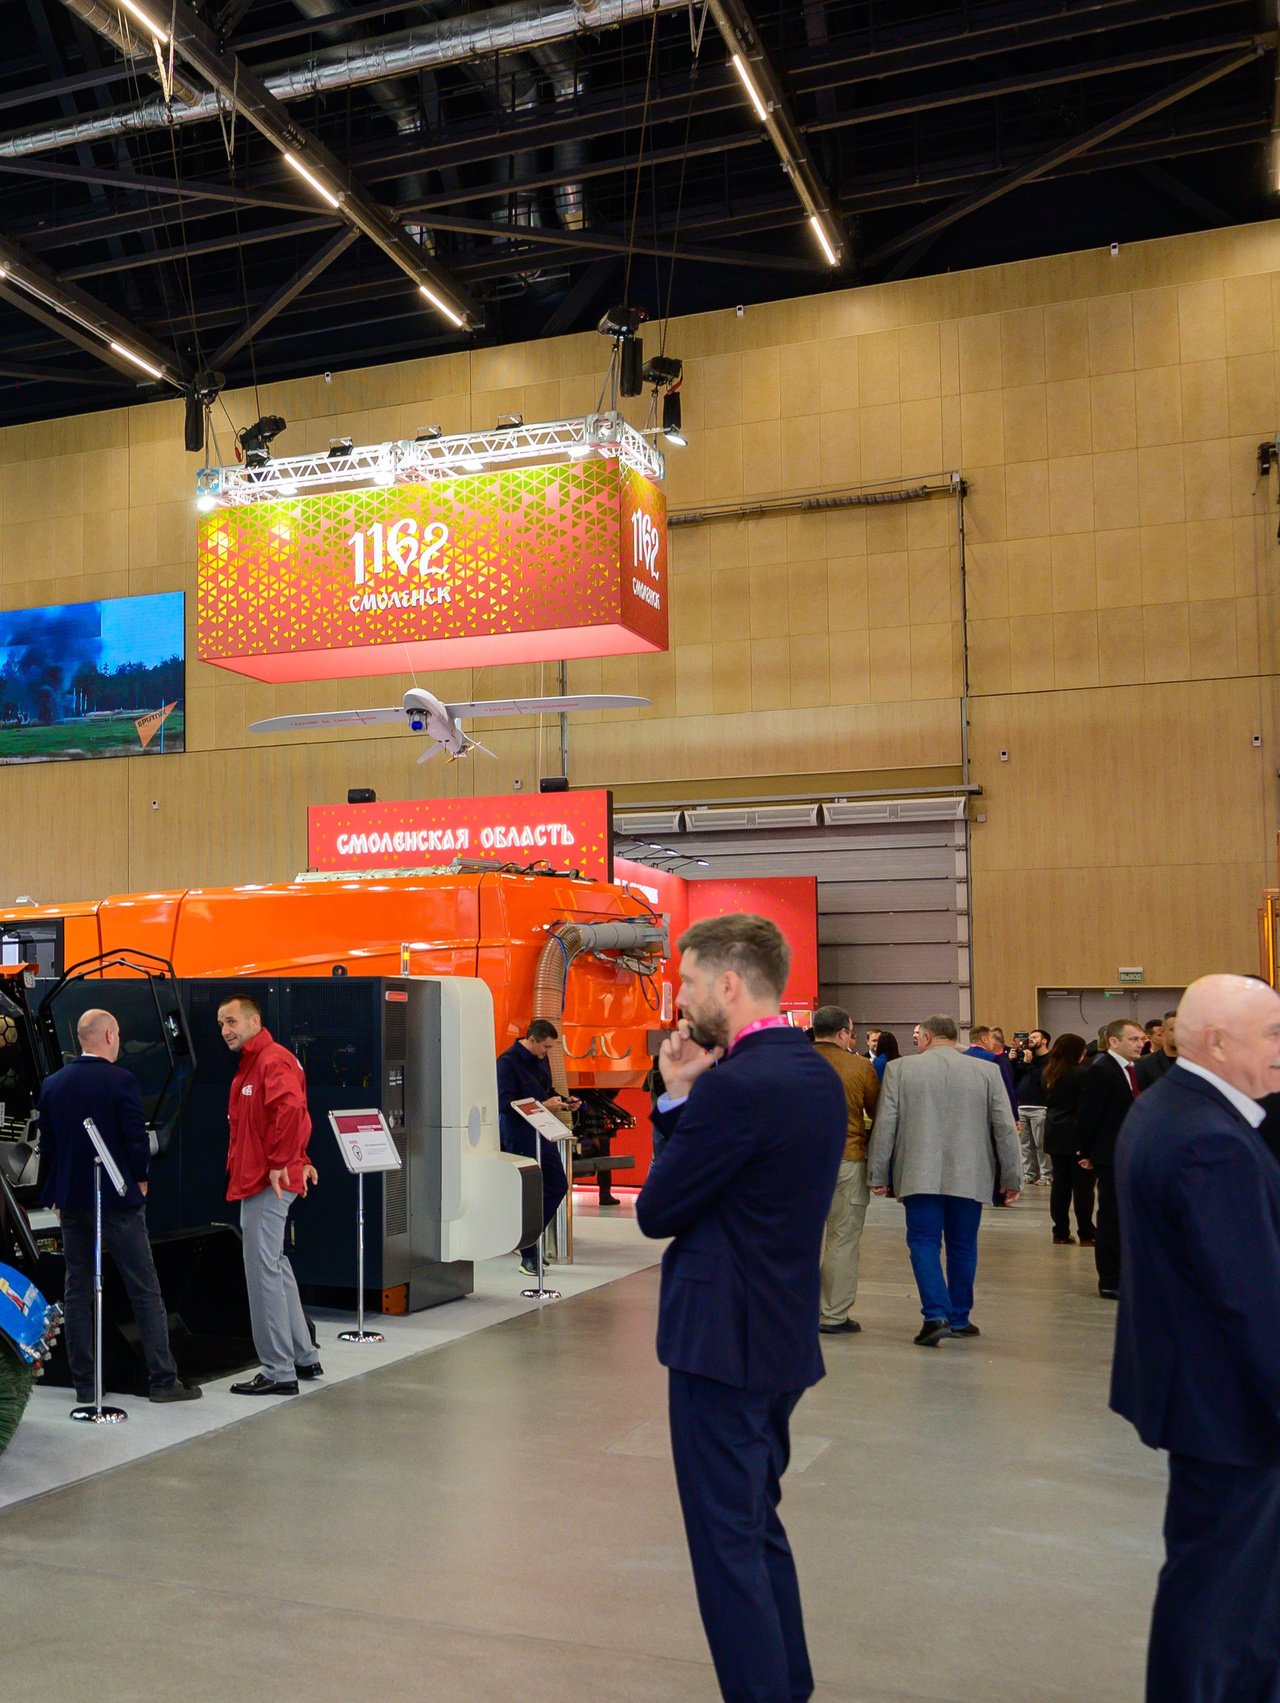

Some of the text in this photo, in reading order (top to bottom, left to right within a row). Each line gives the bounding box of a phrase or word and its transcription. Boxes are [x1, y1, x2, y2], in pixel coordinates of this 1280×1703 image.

[347, 518, 450, 585] 1162
[631, 508, 660, 581] 1162
[349, 585, 452, 613] СМОЛЕНСК
[632, 577, 661, 610] СМОЛЕНСК
[337, 823, 575, 855] СМОЛЕНСКАЯ ОБЛАСТЬ
